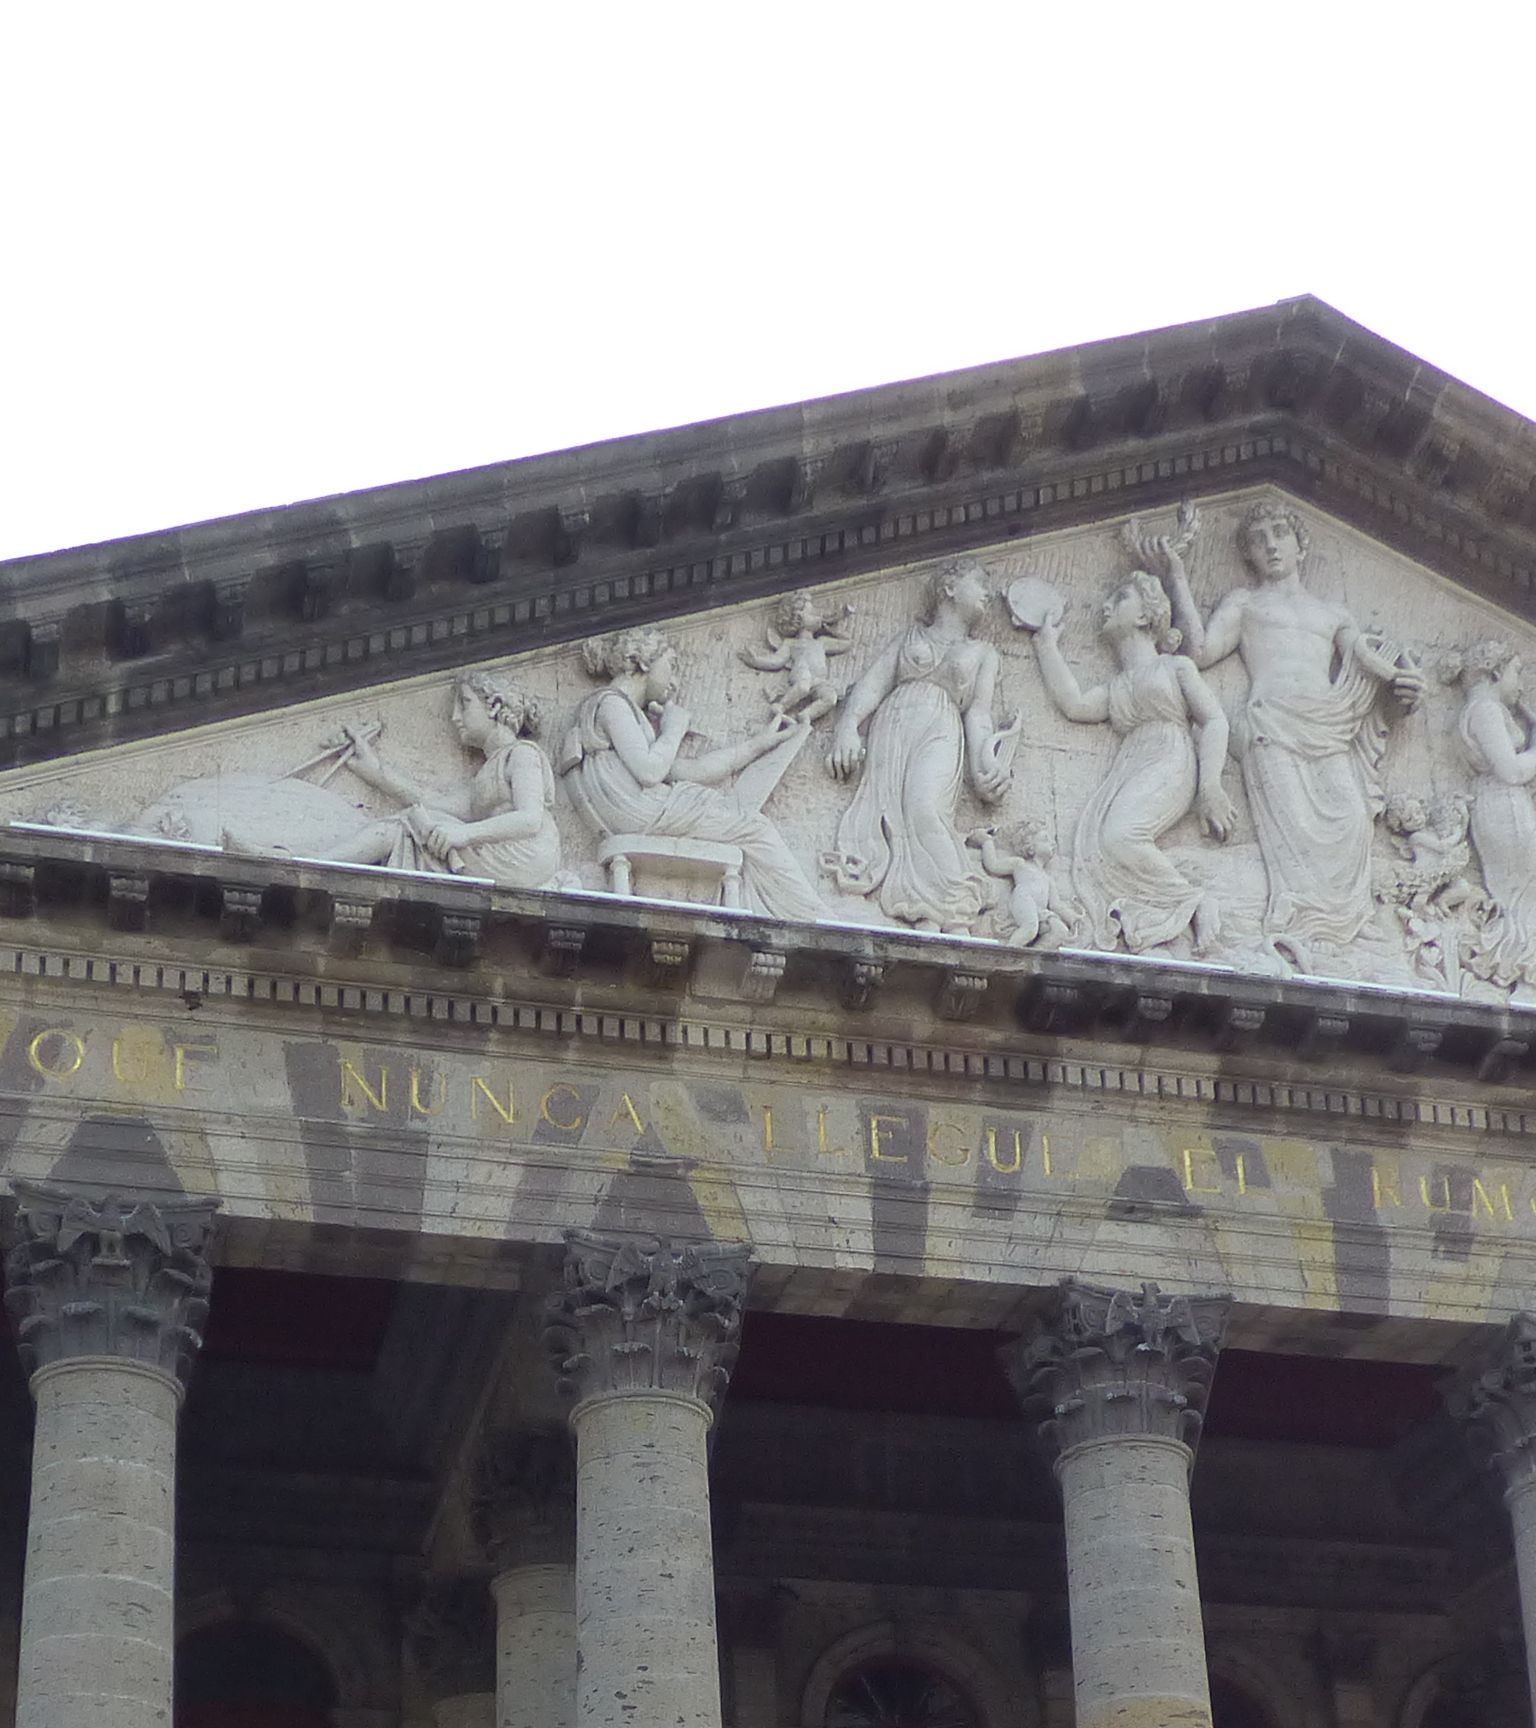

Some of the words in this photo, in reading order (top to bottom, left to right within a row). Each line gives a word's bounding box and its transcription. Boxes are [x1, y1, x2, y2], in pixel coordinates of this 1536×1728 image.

[28, 1028, 217, 1092] QUE
[340, 1060, 647, 1136] NUNCA
[762, 1102, 1084, 1180] LLEGUE
